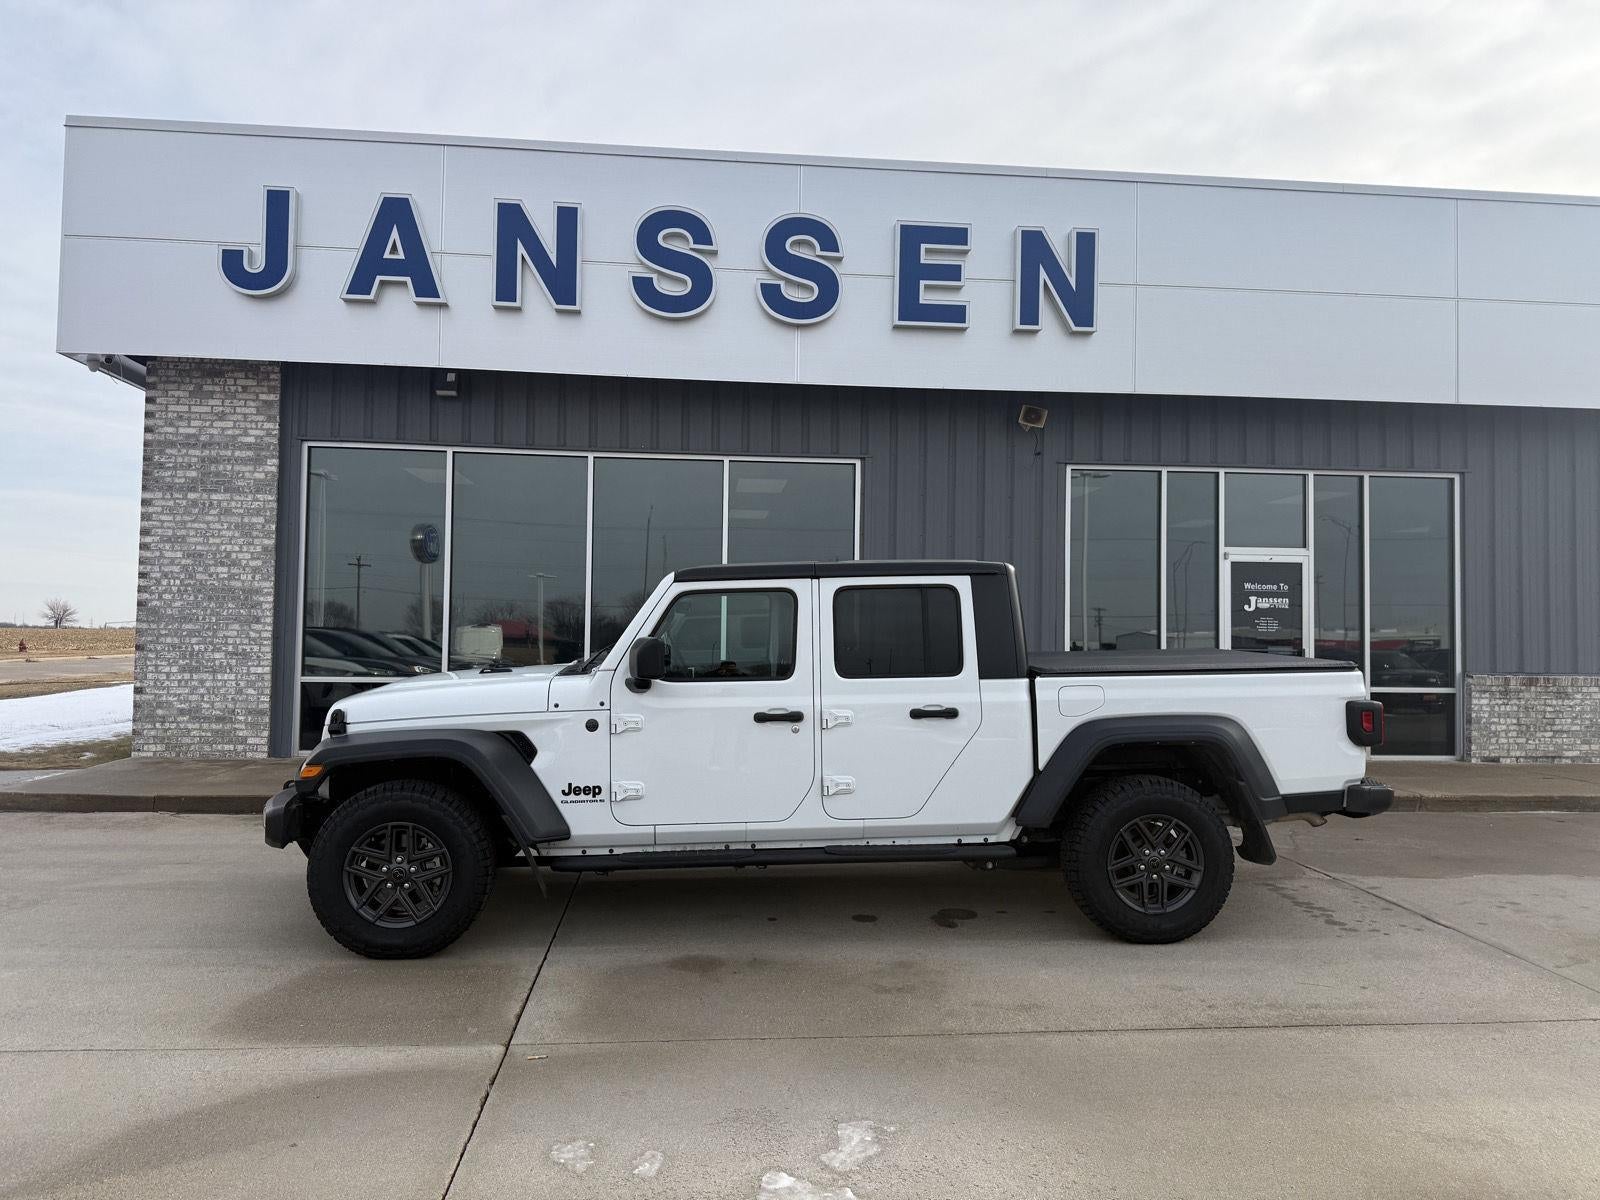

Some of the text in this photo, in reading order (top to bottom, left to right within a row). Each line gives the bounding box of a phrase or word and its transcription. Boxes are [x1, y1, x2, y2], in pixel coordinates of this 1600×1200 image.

[216, 185, 1100, 334] JANSSEN
[1243, 582, 1278, 590] Welcome
[1243, 596, 1289, 611] Janssen
[561, 782, 602, 798] Jeep
